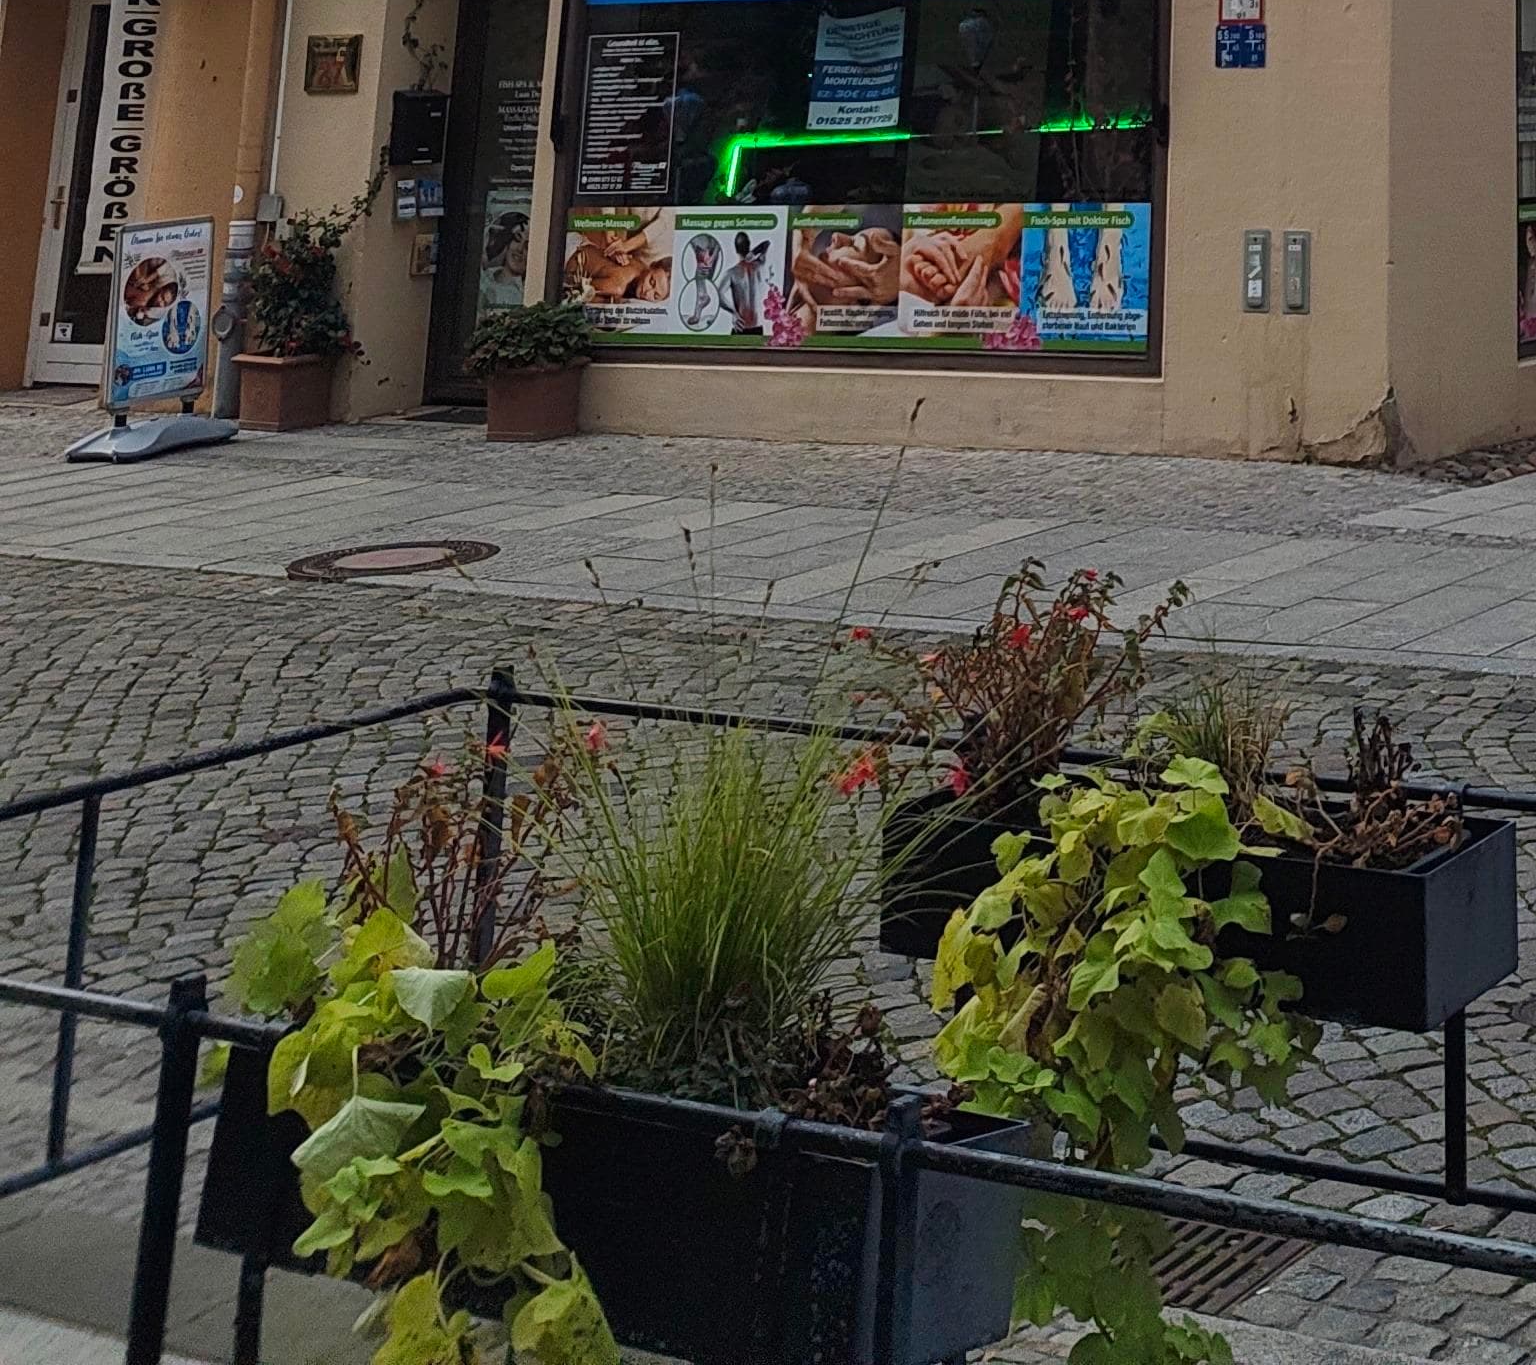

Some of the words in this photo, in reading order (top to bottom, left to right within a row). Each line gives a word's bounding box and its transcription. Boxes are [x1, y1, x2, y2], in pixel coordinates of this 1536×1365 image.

[574, 218, 635, 230] Wellness-Massage
[681, 217, 712, 228] Massage
[713, 218, 734, 229] gegen
[735, 217, 774, 228] Schmerzen
[1031, 215, 1066, 227] Fisch-Spa
[1067, 215, 1081, 225] mit
[1082, 215, 1109, 226] Doktor
[1110, 214, 1131, 226] Fisch
